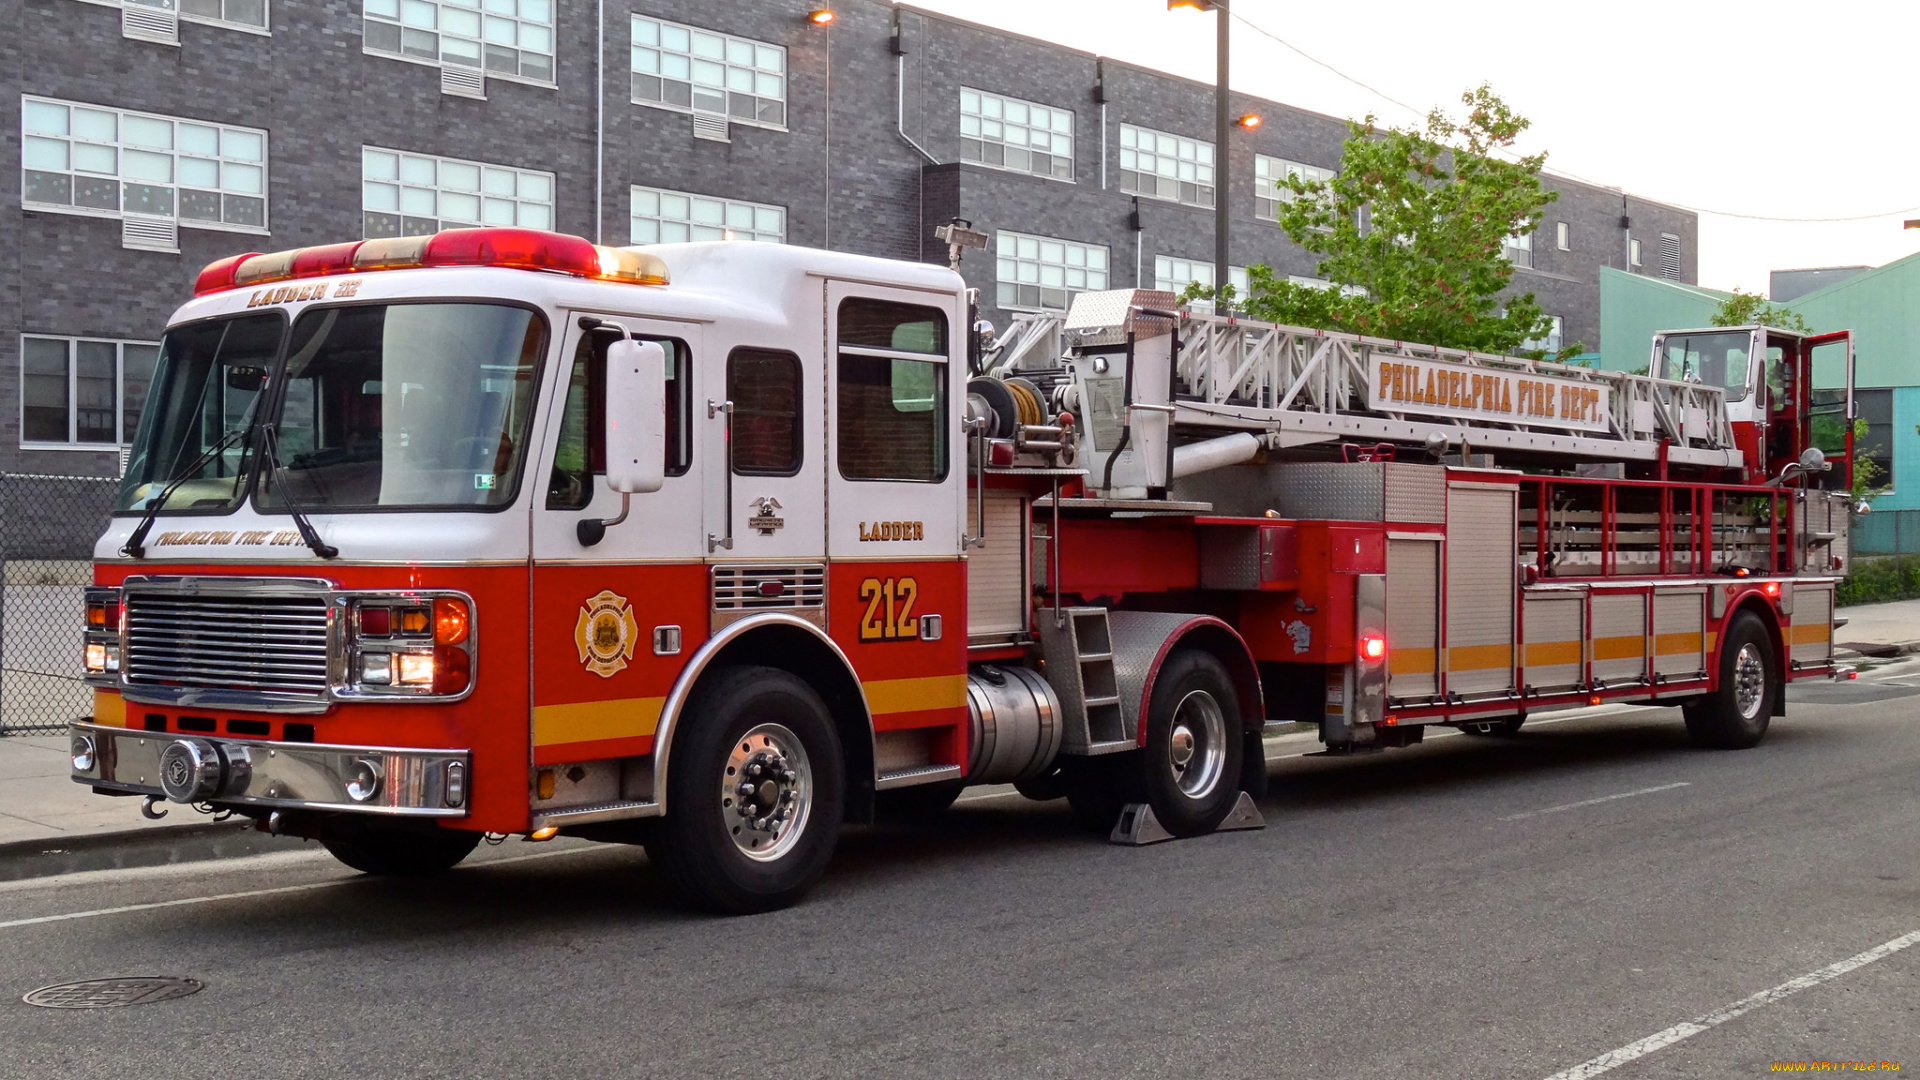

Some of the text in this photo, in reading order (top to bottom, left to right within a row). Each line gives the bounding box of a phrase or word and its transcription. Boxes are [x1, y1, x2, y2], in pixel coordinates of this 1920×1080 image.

[247, 283, 328, 307] LADDER
[1379, 362, 1603, 423] PHILADELPHIA FIRE DEPT.
[154, 531, 237, 546] PHILADELPHIA
[235, 531, 272, 545] FIRE
[859, 521, 923, 541] LADDER
[589, 603, 623, 619] PHILADELPHIA
[859, 577, 917, 643] 212
